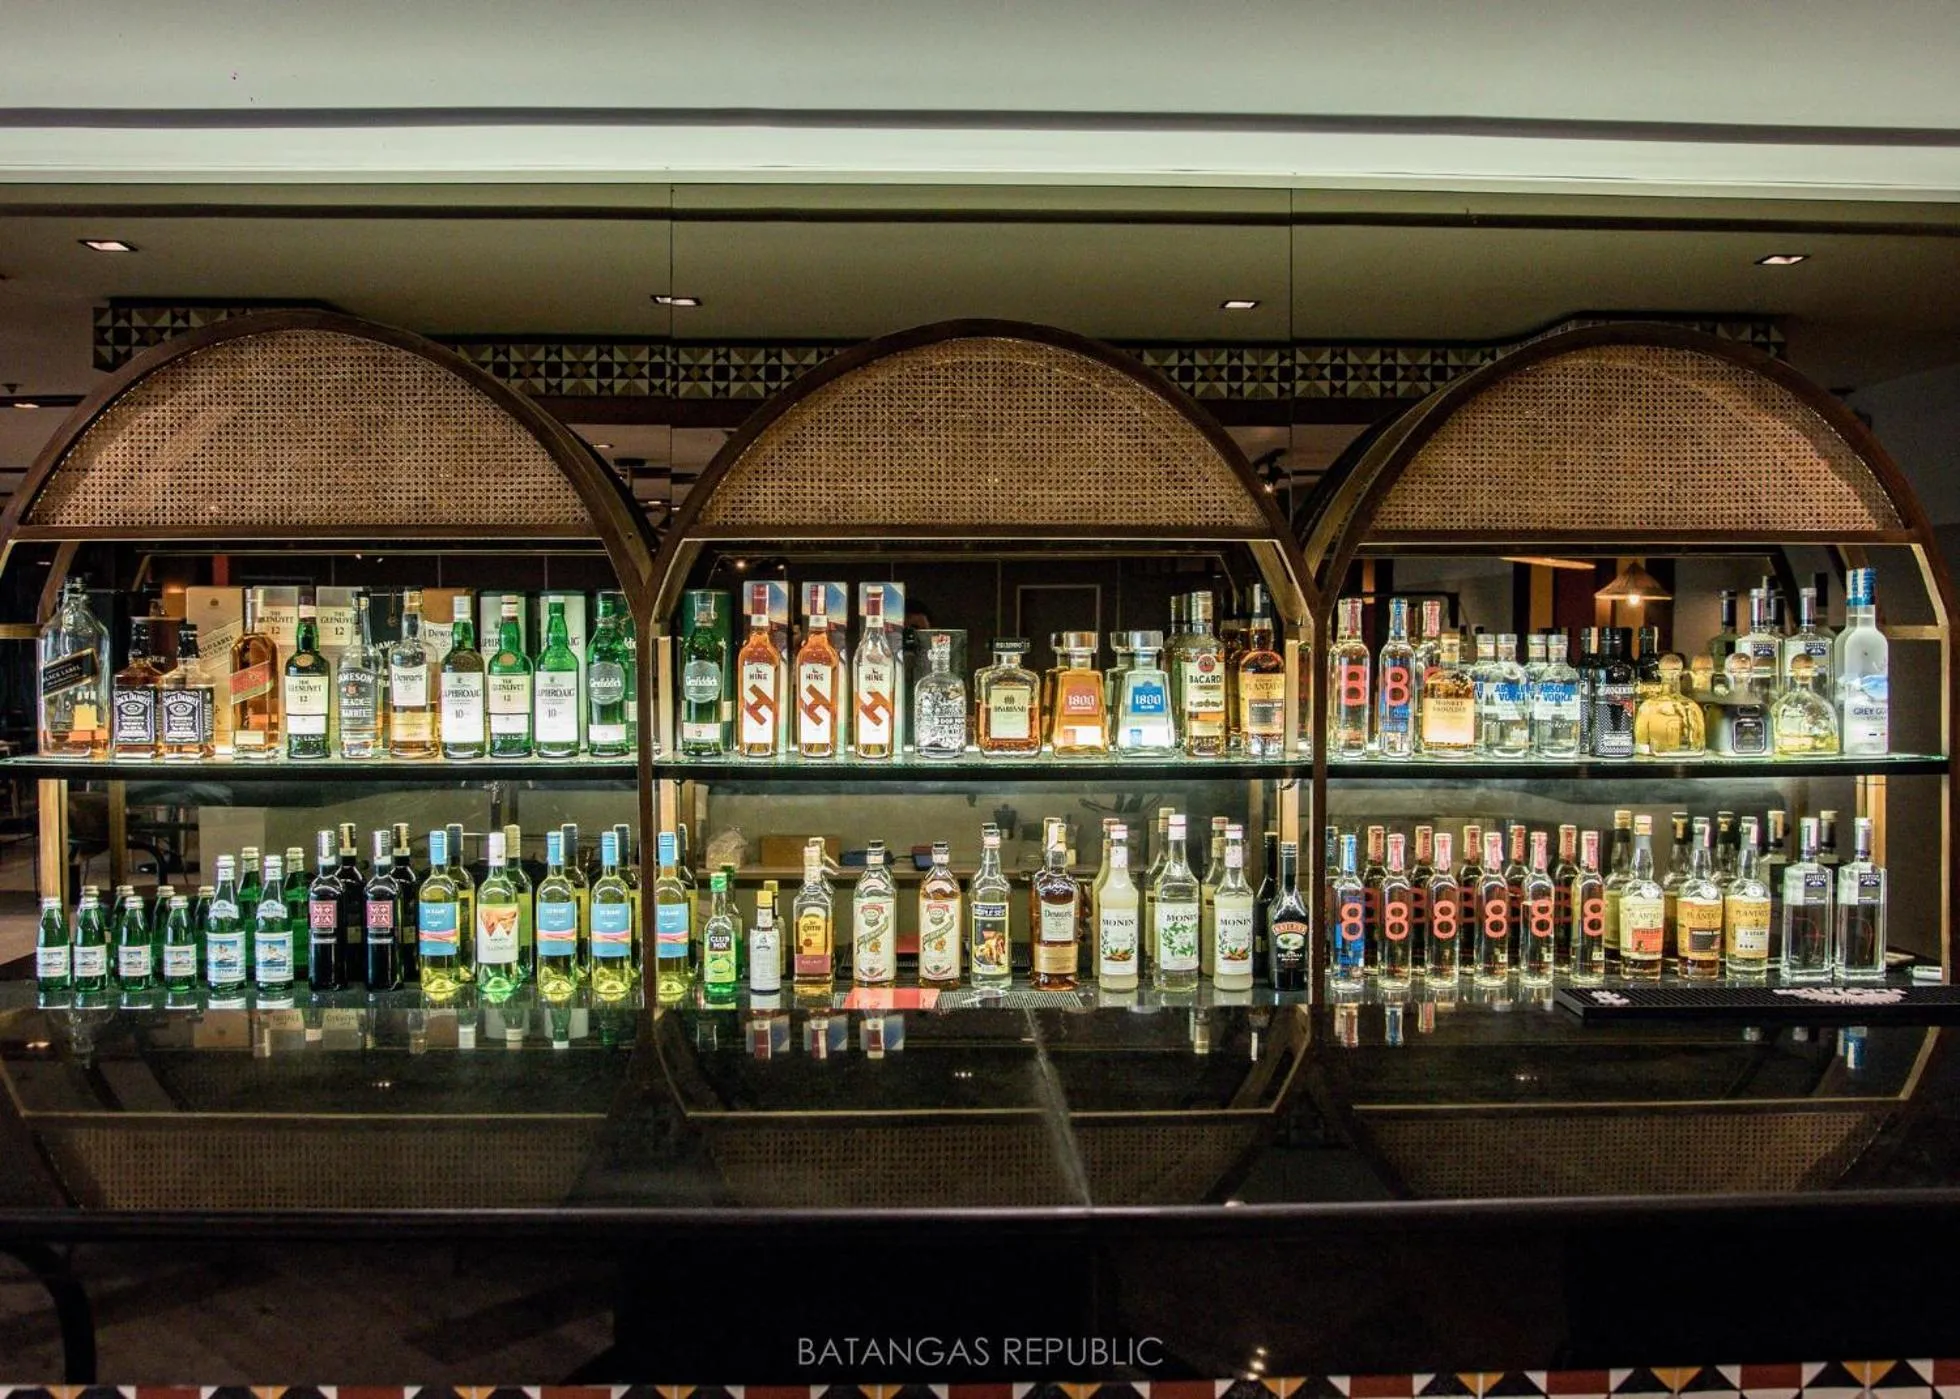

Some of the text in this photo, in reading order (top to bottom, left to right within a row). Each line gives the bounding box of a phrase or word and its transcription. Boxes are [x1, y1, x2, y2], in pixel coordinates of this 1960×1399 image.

[750, 674, 768, 682] HINE
[806, 674, 824, 682] HINE
[865, 674, 883, 682] HINE
[1068, 695, 1095, 706] 1800
[1135, 694, 1161, 705] 1800
[455, 710, 464, 718] 10
[548, 709, 557, 718] 10
[1854, 708, 1875, 716] GREY
[1102, 918, 1134, 927] MONIN
